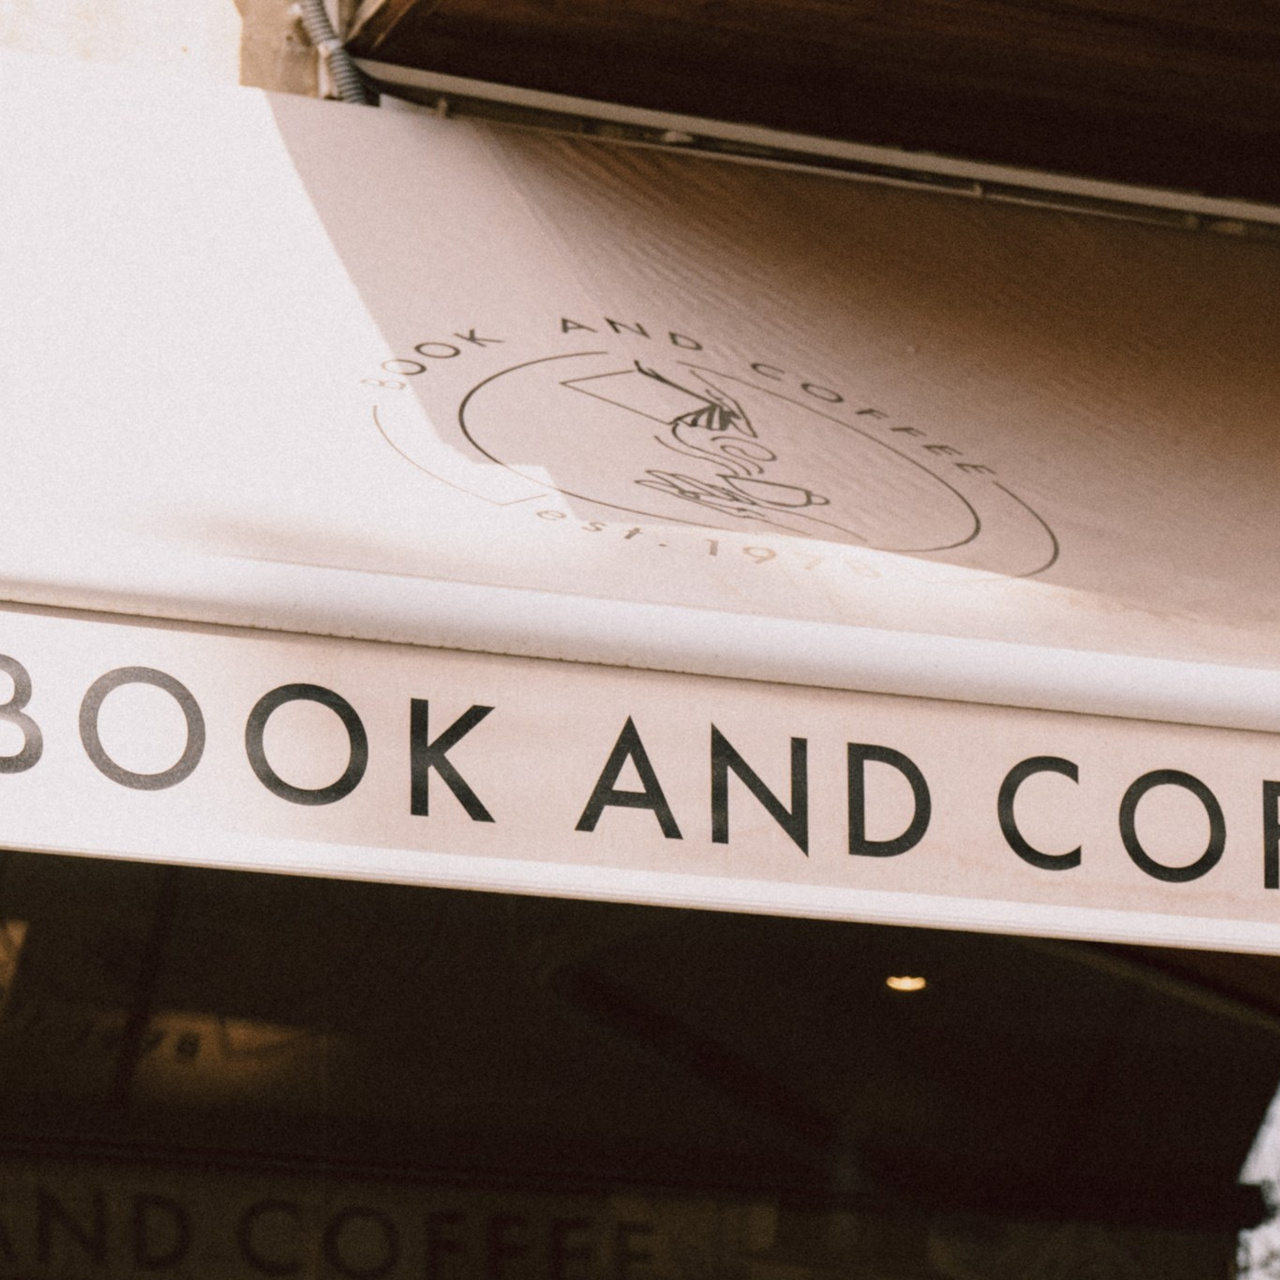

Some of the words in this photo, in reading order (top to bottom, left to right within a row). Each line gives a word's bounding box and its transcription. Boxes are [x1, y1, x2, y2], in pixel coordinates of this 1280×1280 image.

[359, 328, 503, 393] BOOK
[560, 316, 704, 352] AND
[750, 360, 998, 478] COFFEE
[574, 714, 932, 858] AND
[0, 1184, 196, 1271] ND
